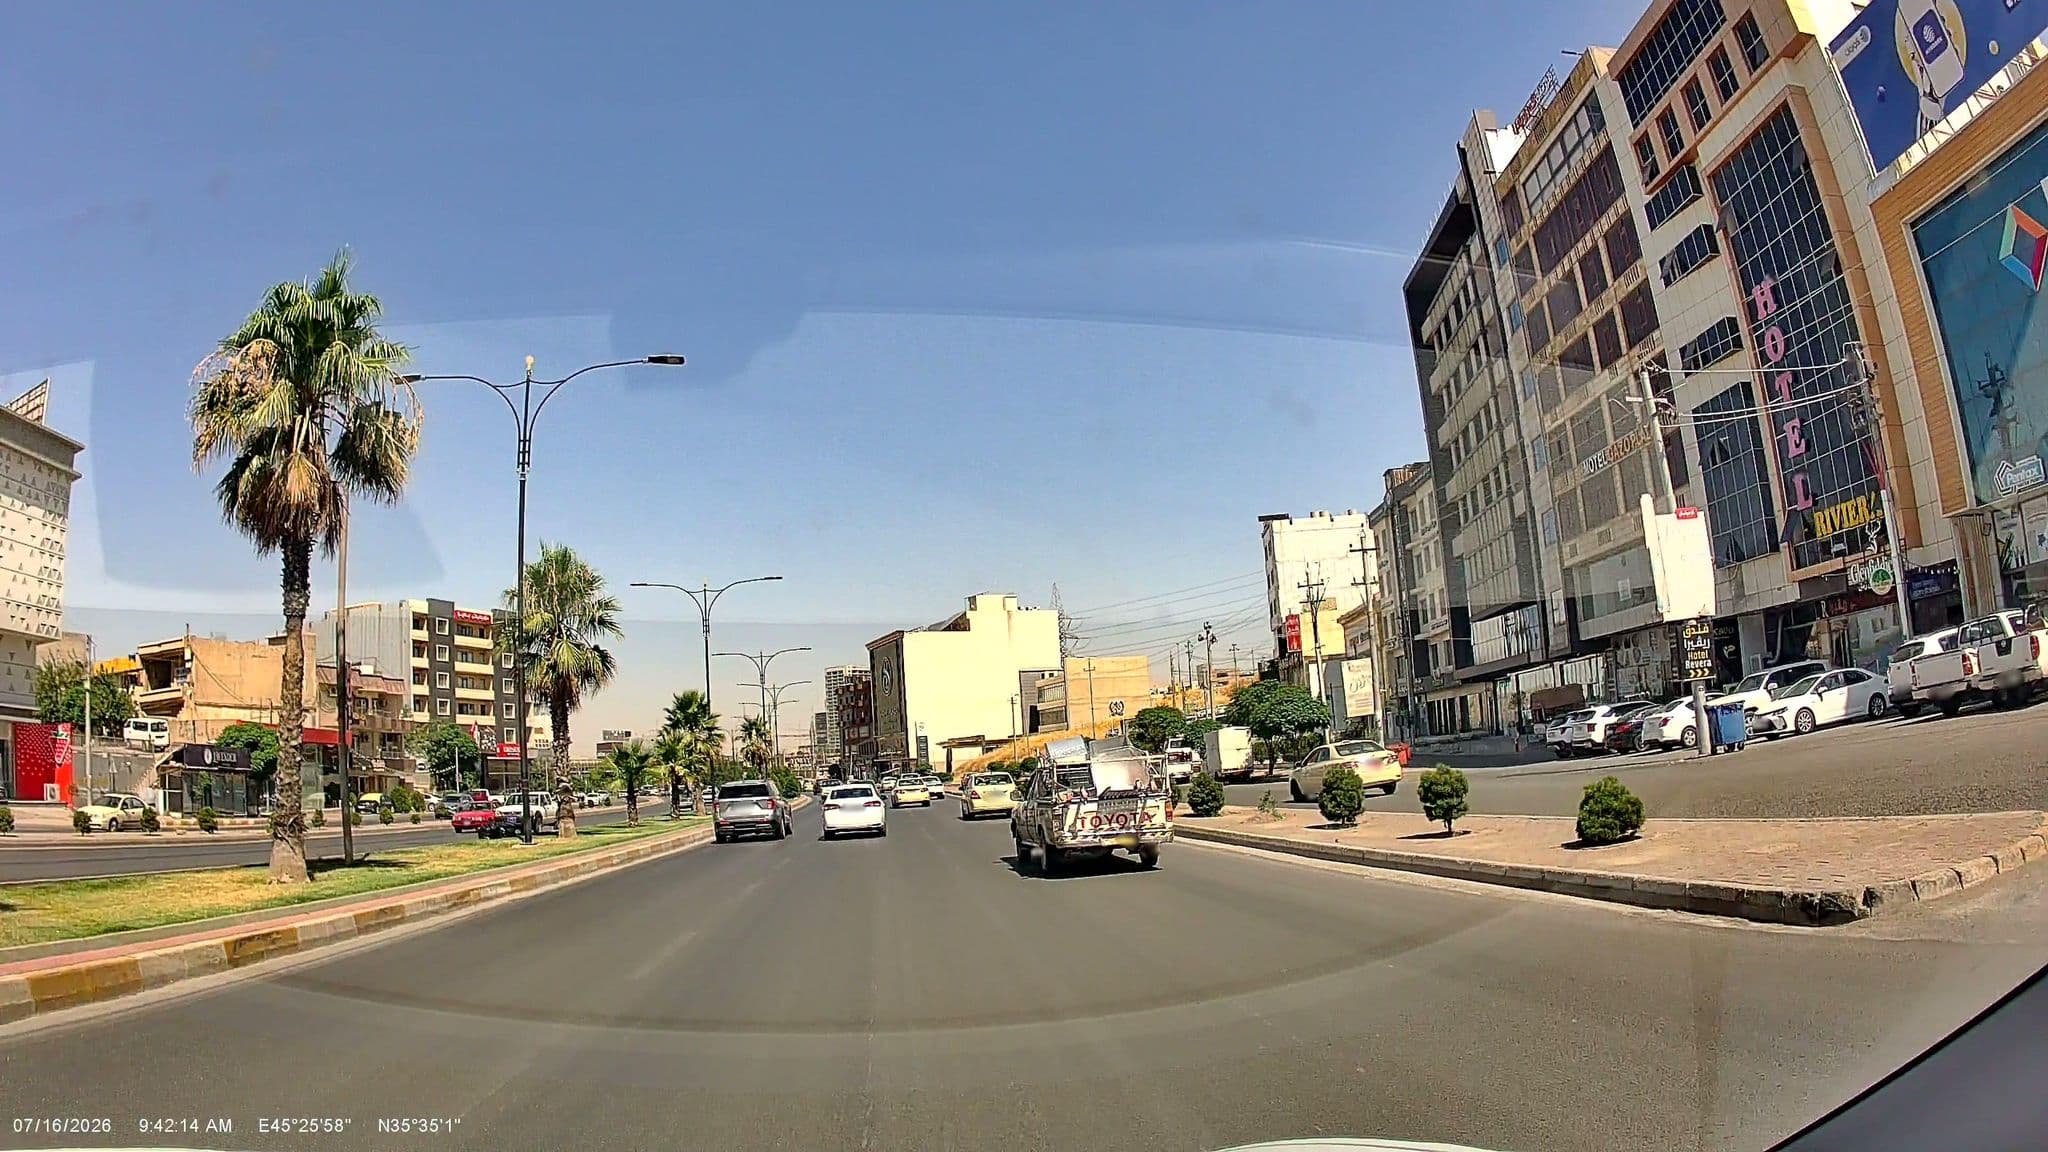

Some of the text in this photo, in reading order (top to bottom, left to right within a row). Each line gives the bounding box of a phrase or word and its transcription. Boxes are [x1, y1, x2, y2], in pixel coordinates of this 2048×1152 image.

[1752, 280, 1813, 511] HOTEL
[1583, 449, 1608, 474] HOTEL
[1683, 623, 1710, 639] فندق
[1687, 650, 1709, 661] Hotel
[1685, 660, 1712, 669] Revera
[1077, 811, 1154, 830] TOYOTA
